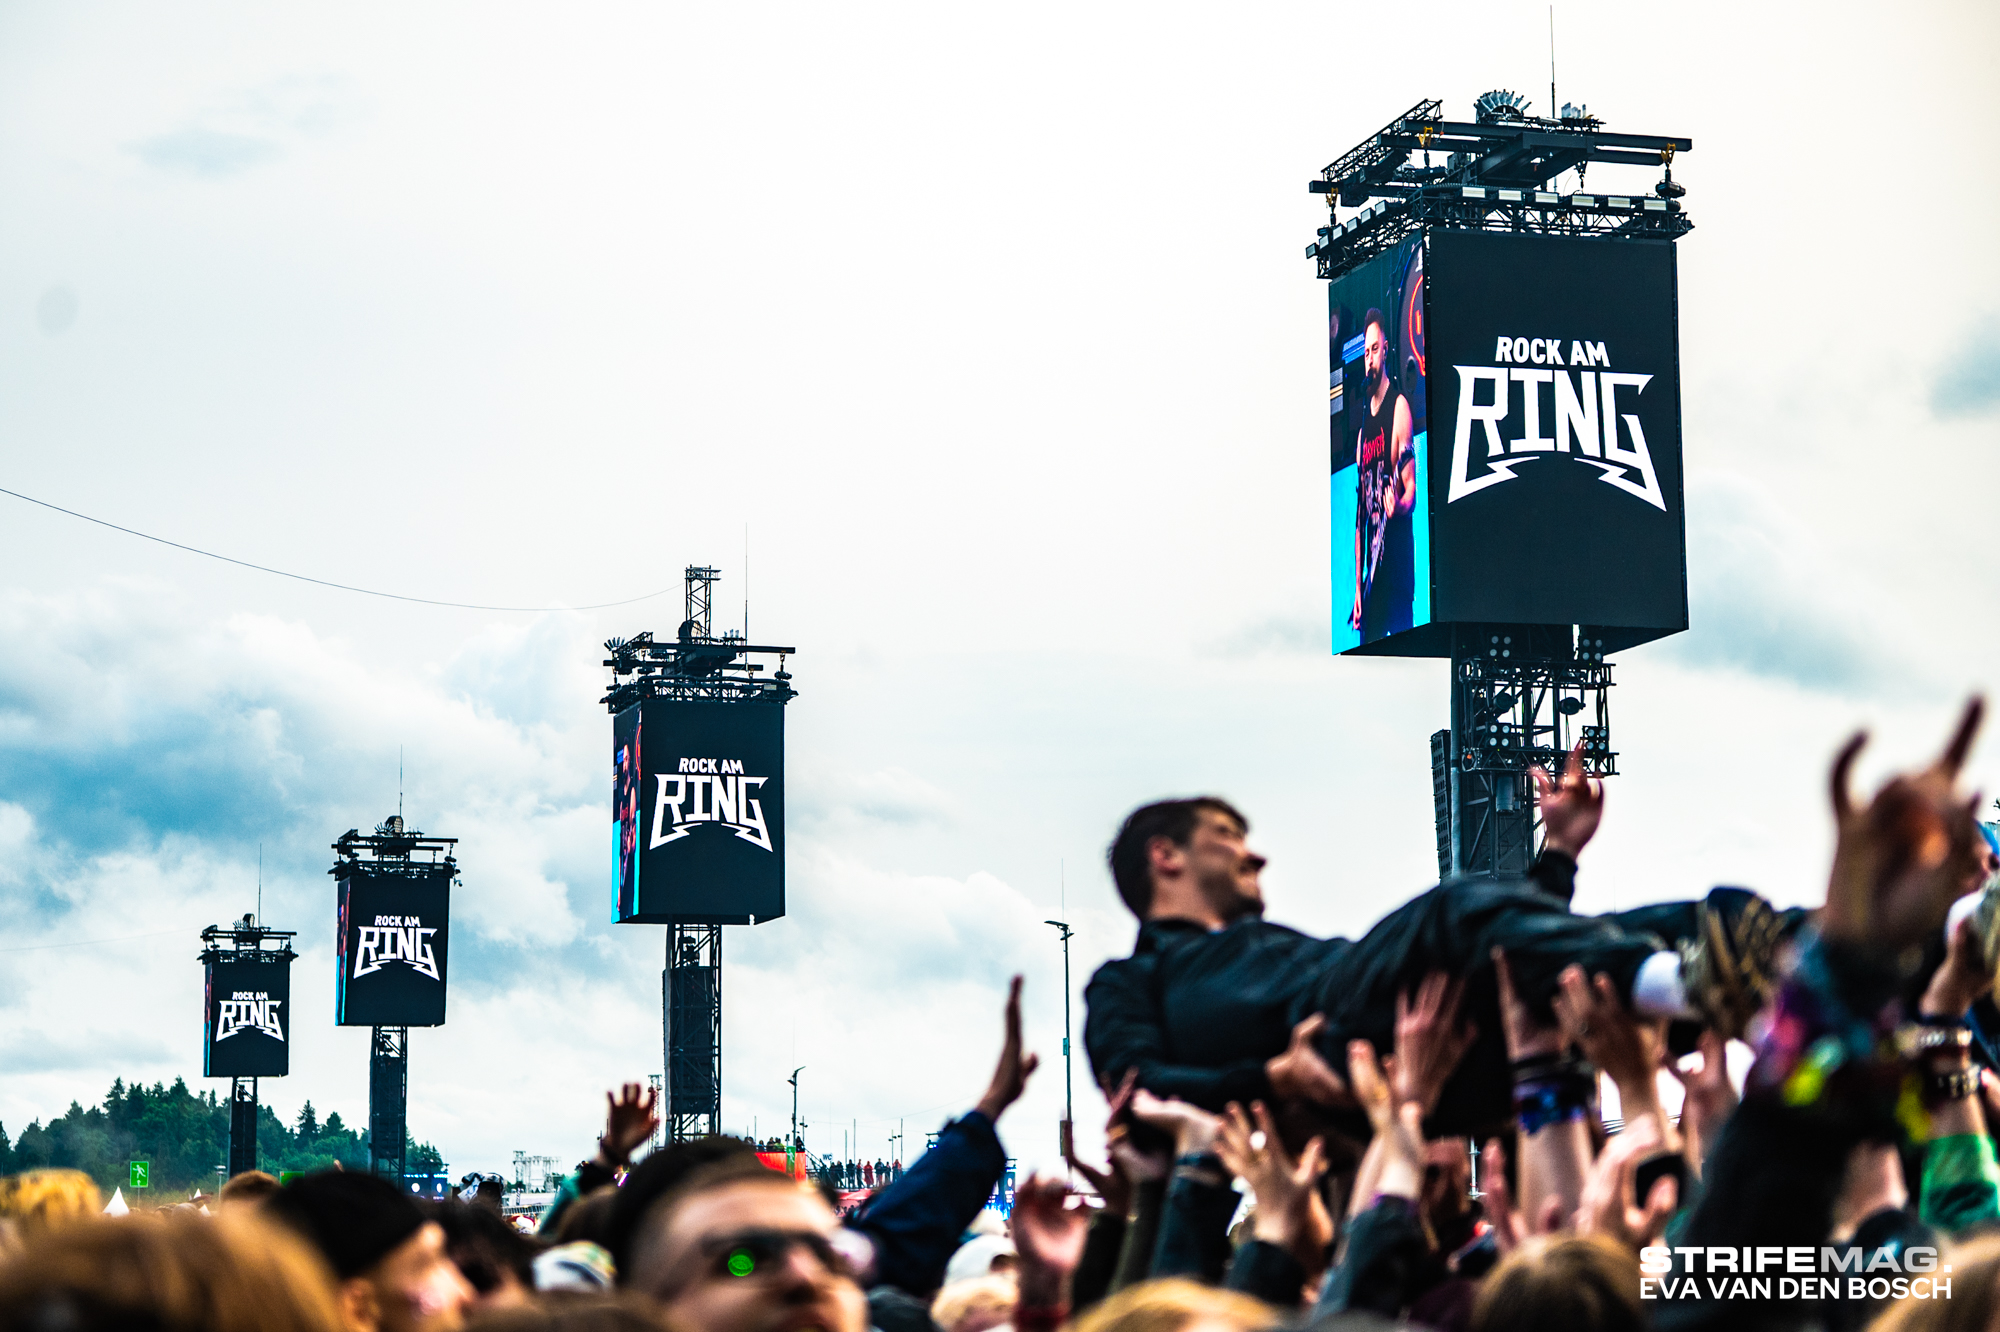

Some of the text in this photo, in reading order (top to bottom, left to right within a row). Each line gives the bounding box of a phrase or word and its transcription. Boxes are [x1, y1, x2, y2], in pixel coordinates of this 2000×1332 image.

[1495, 336, 1611, 367] ROCK AM
[1448, 365, 1667, 512] RING
[678, 757, 744, 774] ROCK AM
[649, 773, 774, 853] RING
[374, 915, 420, 927] ROCK AM
[353, 926, 440, 981] RING
[232, 991, 268, 1001] ROCK AM
[216, 1000, 285, 1042] RING
